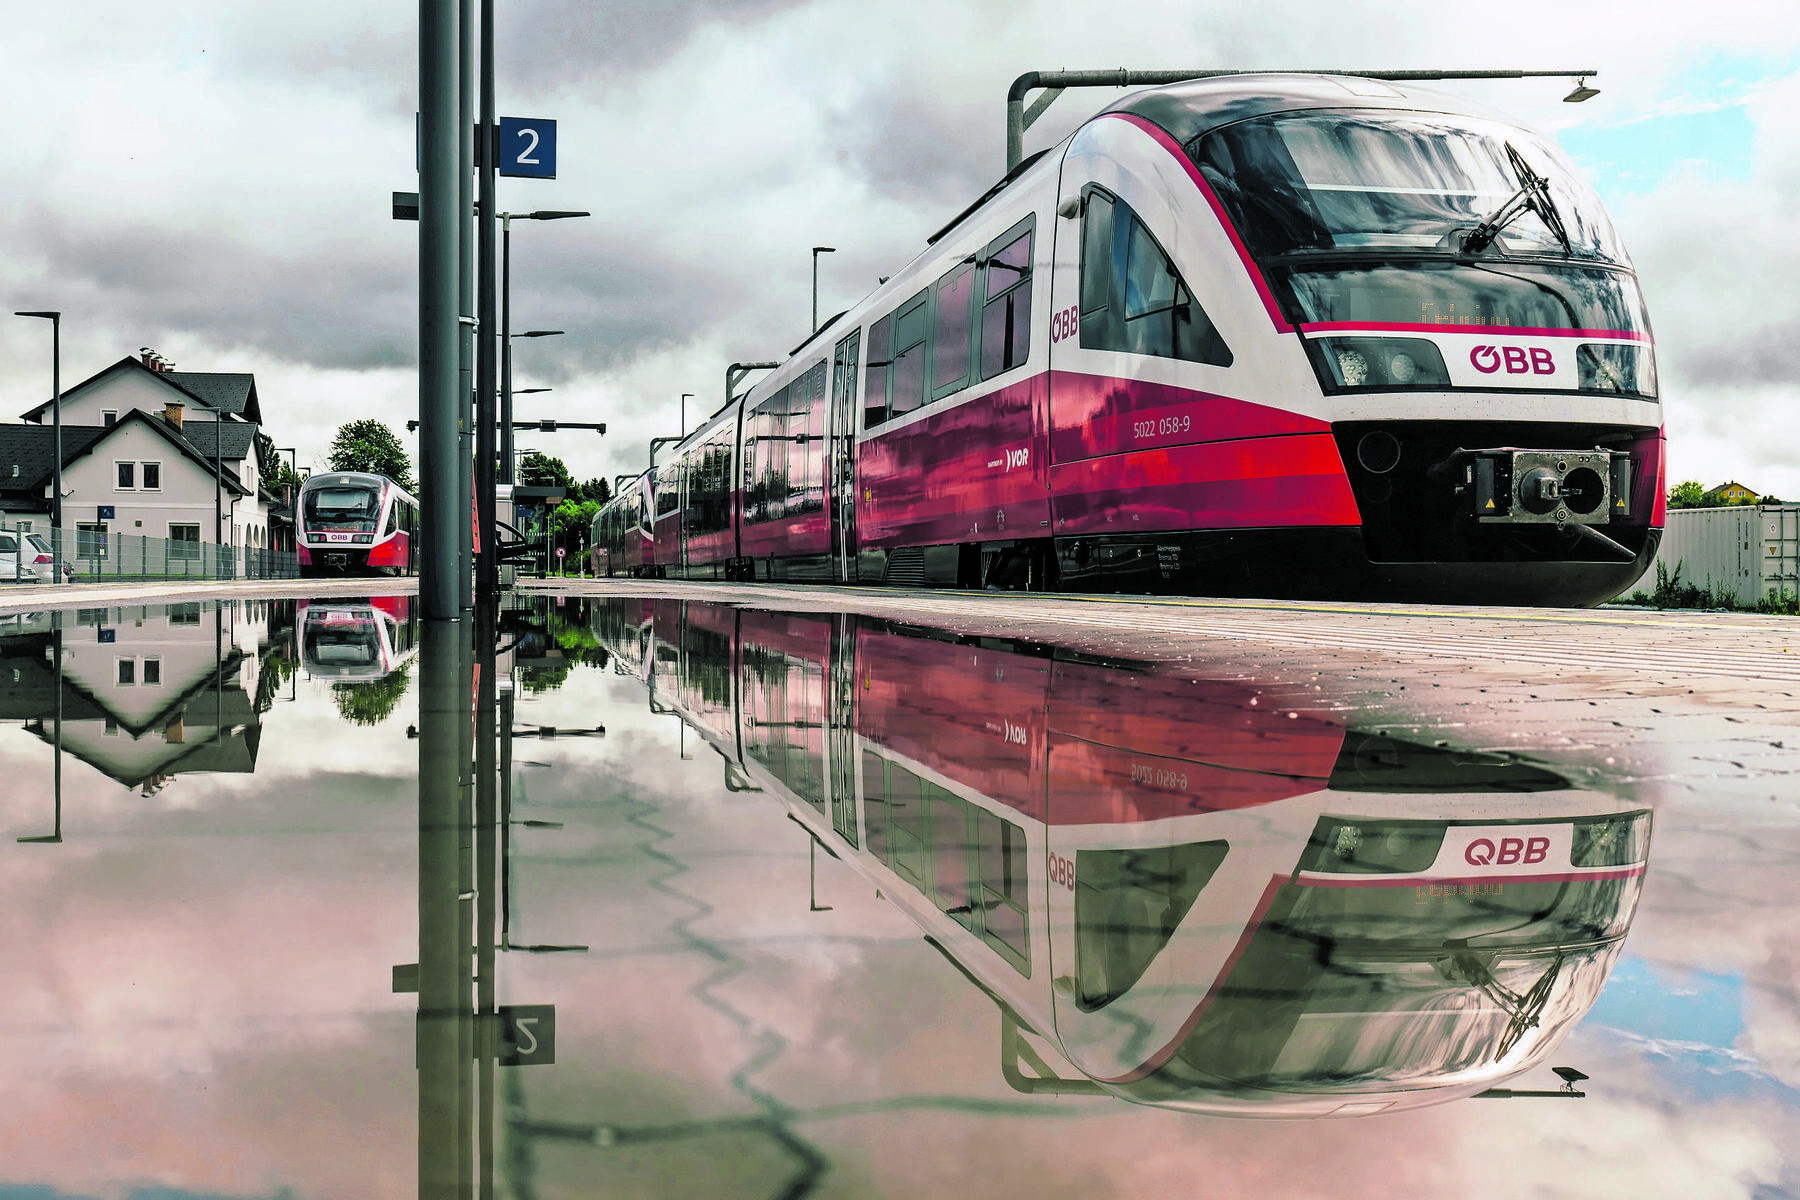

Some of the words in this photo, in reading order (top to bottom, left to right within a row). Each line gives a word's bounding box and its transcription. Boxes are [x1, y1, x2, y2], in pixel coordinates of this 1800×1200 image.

[516, 128, 540, 165] 2
[1051, 305, 1078, 344] ÖBB
[1469, 345, 1556, 375] ÖBB
[1133, 420, 1155, 439] 5022
[1159, 415, 1190, 435] 058-9
[1011, 448, 1029, 468] VOR
